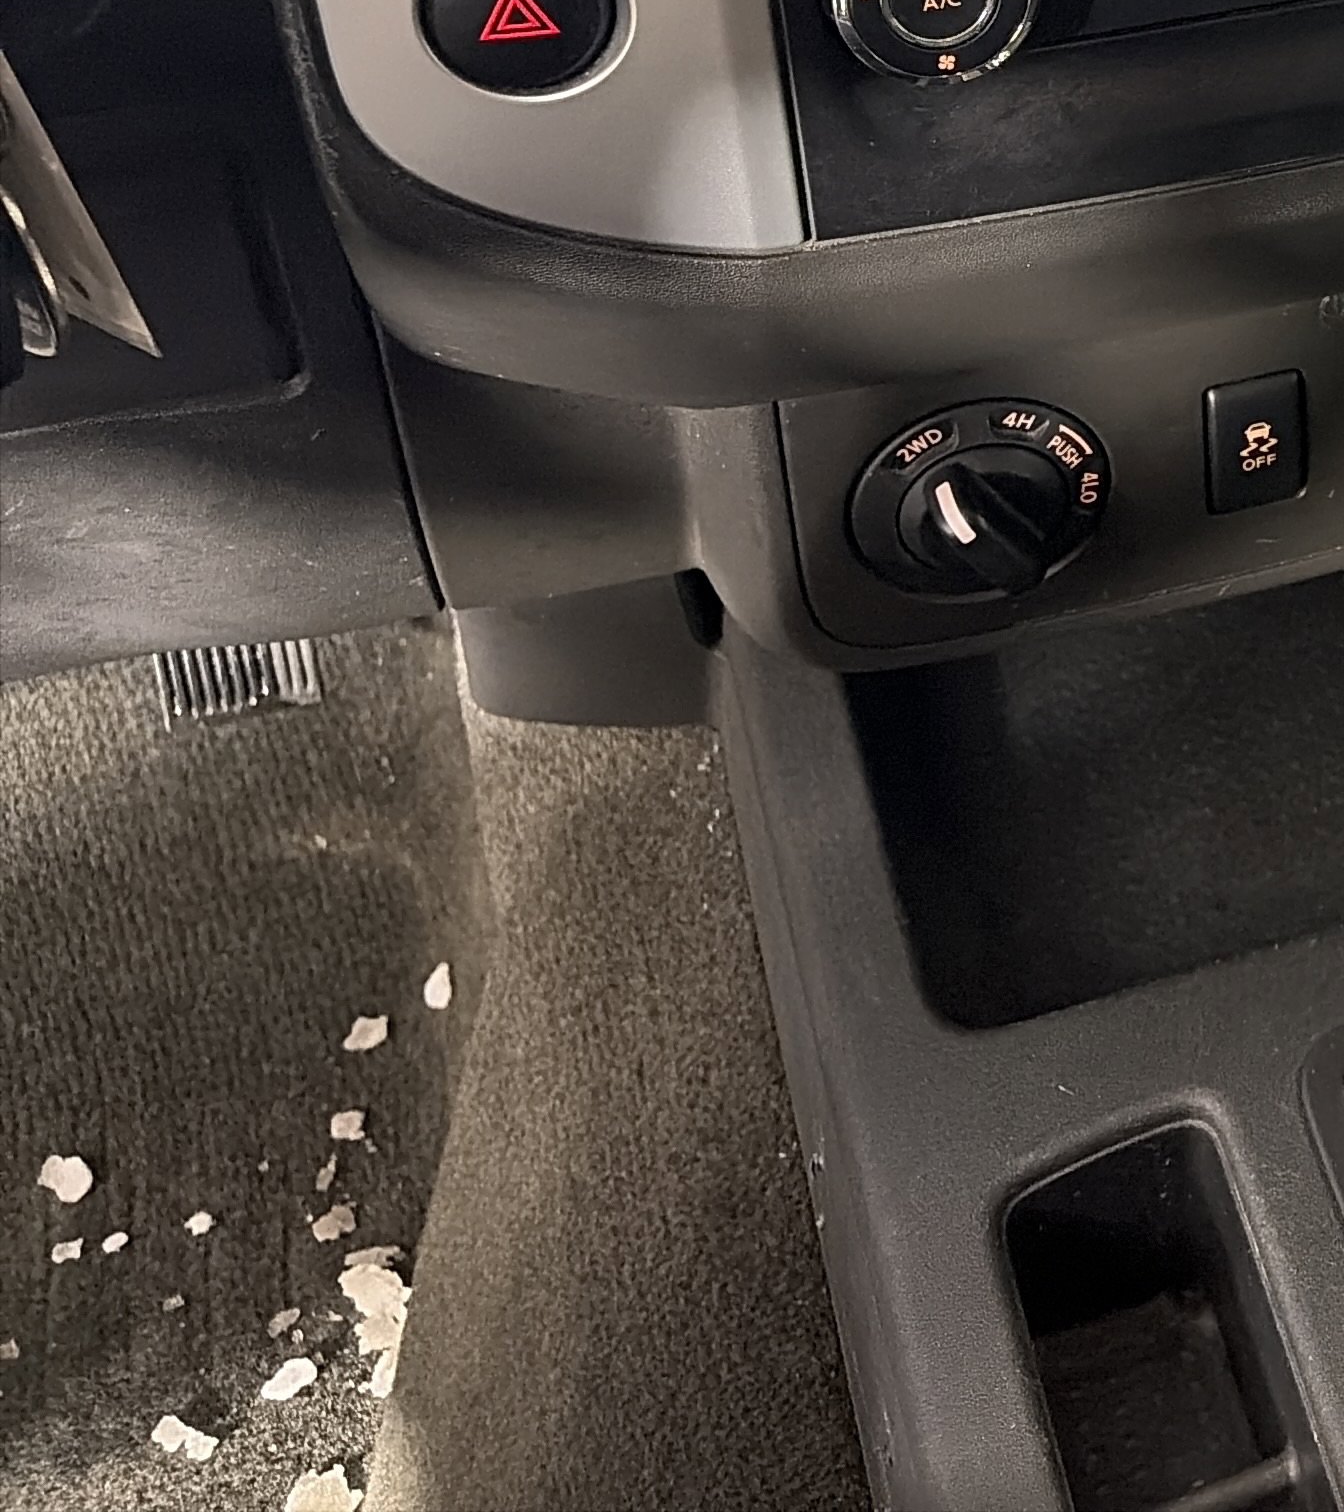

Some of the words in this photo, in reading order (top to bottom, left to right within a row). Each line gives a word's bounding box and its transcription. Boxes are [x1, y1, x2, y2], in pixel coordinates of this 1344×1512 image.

[1002, 411, 1037, 431] 4H
[895, 428, 943, 464] 2WD
[1046, 435, 1084, 470] PUSH
[1242, 452, 1278, 473] OFF
[1079, 472, 1100, 505] 4LO
